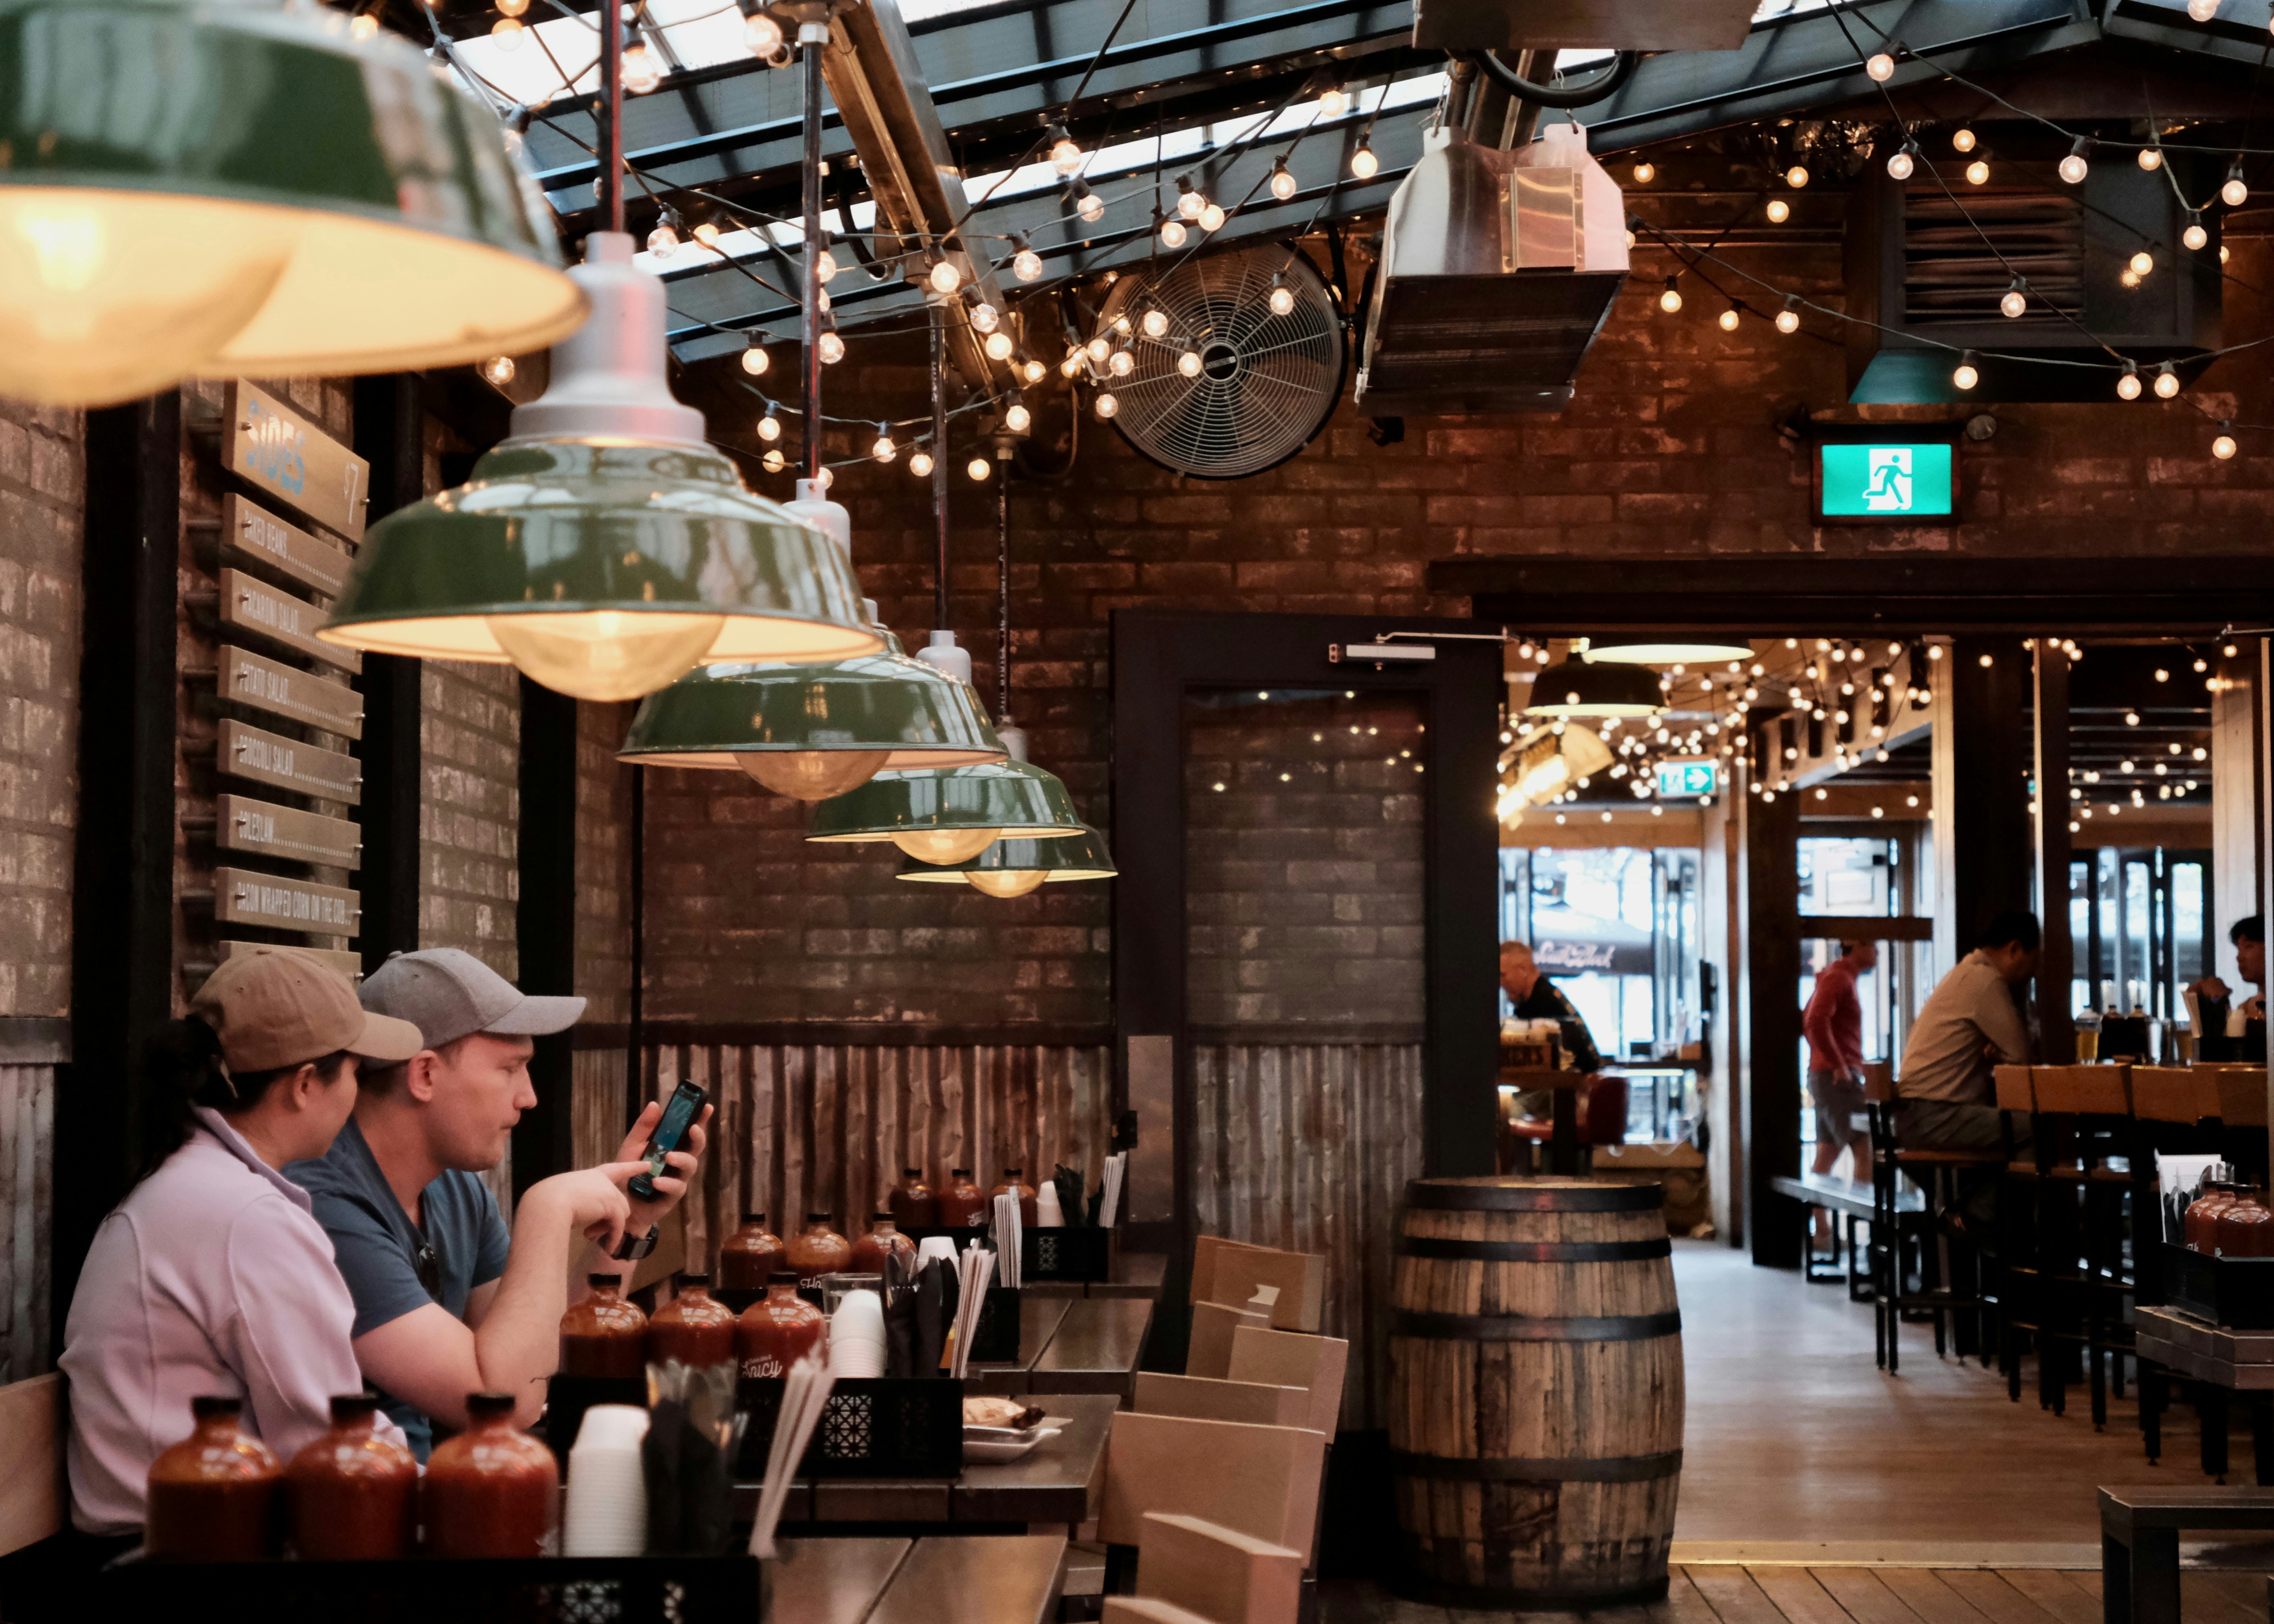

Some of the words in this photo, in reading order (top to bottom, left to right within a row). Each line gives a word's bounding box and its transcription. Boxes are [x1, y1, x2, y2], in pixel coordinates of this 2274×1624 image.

[245, 399, 306, 495] SIDES
[267, 522, 287, 559] BEANS
[278, 603, 298, 635] SALAD
[267, 672, 288, 705] SALAD
[239, 735, 271, 770] BROCCOLI
[273, 746, 293, 776] SALAD
